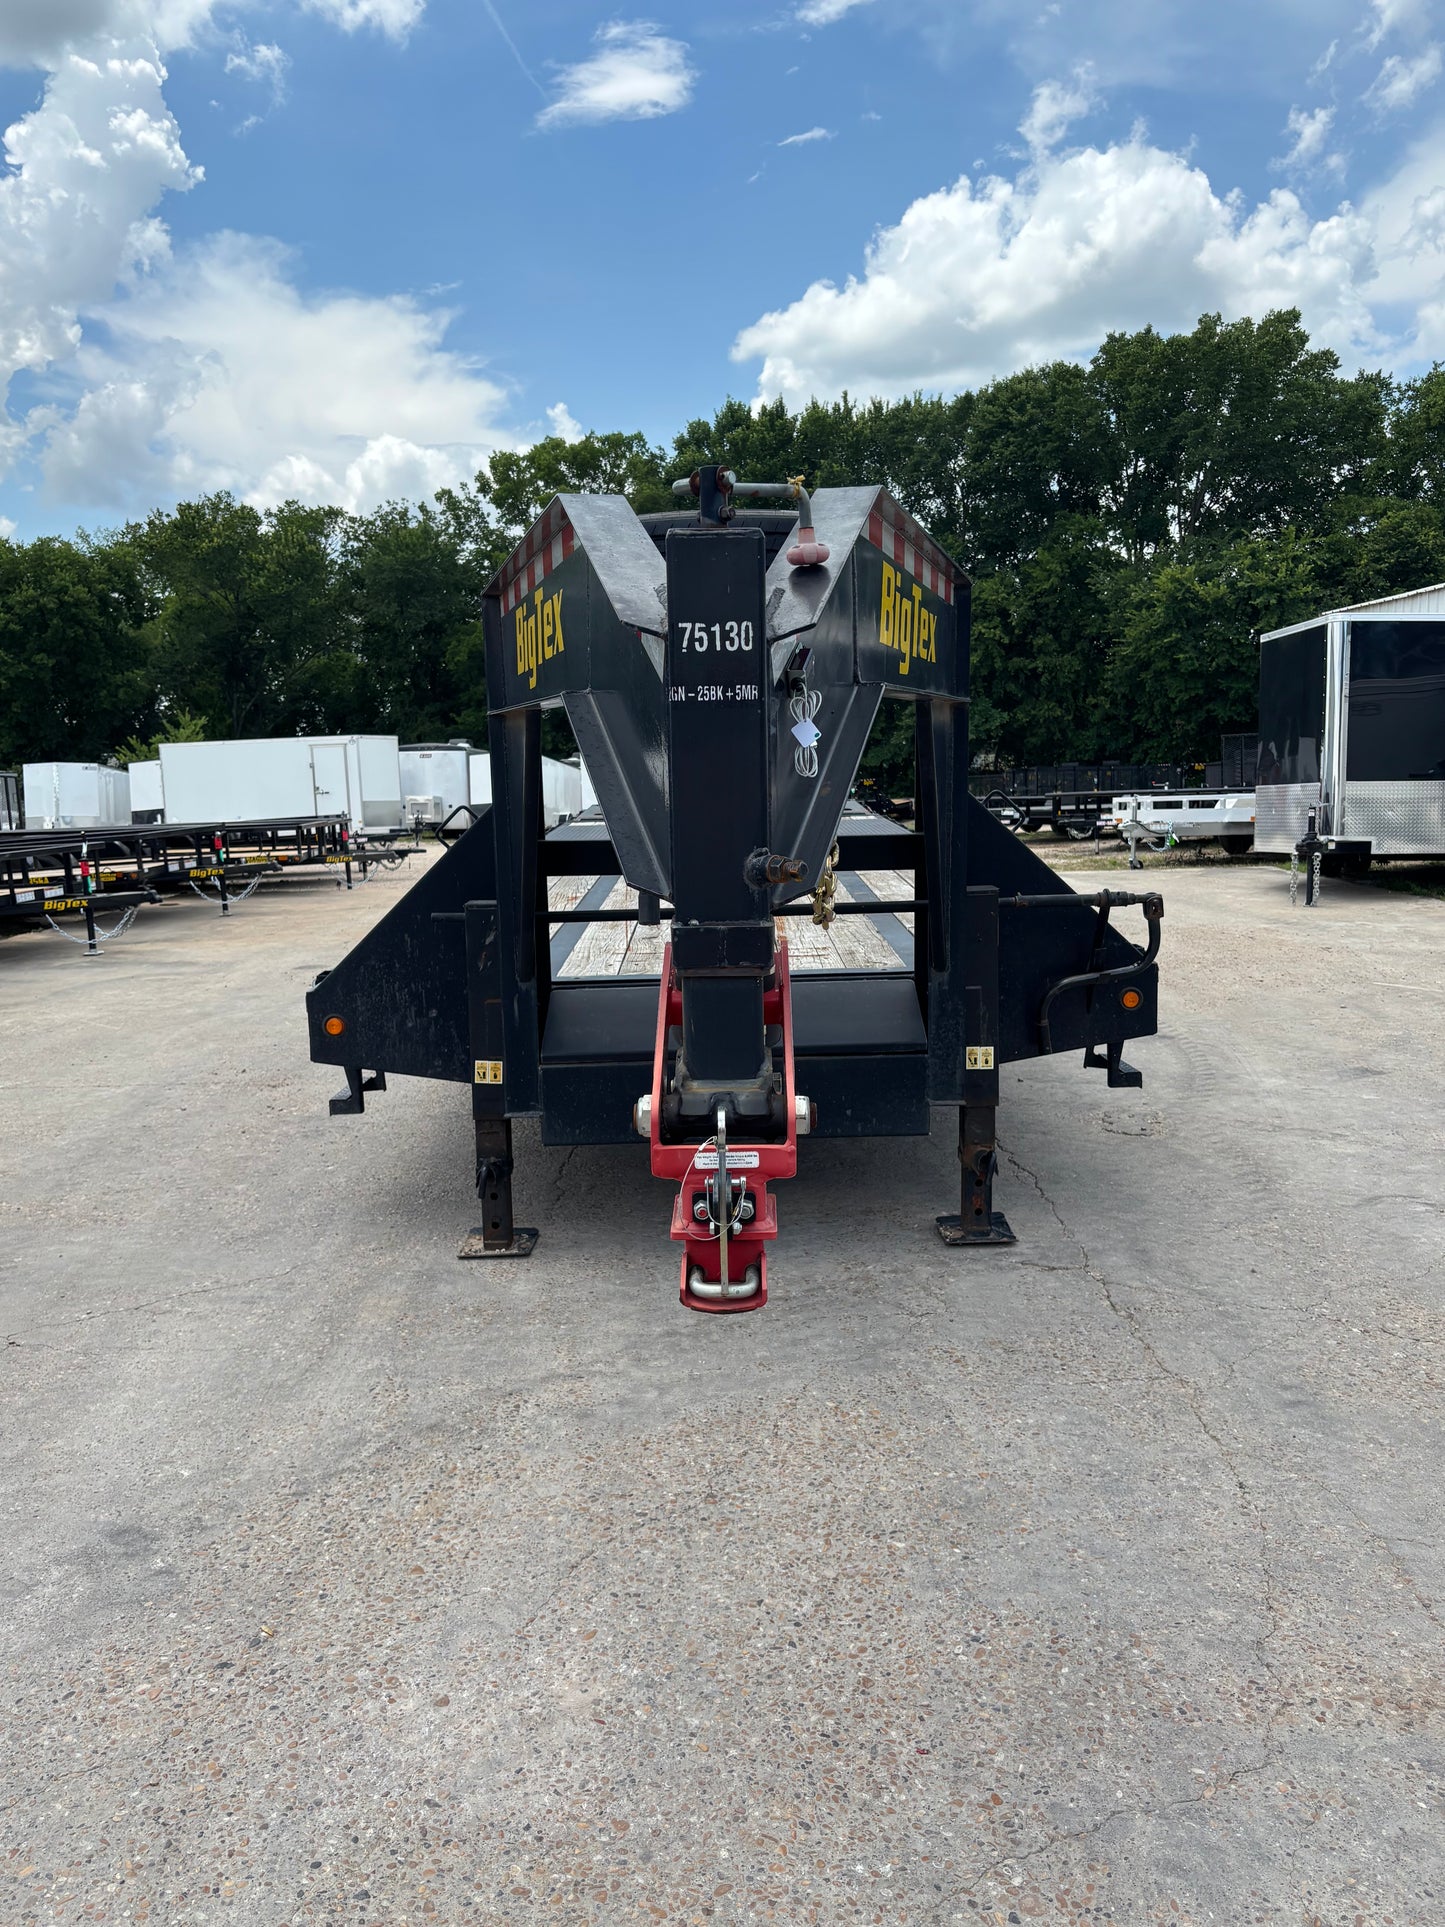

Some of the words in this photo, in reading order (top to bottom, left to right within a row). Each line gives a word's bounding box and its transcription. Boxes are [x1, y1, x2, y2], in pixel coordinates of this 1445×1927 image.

[880, 560, 937, 675] BigTex
[515, 586, 565, 690] BigTex
[678, 620, 753, 652] 75130
[189, 867, 224, 878] BigTex
[43, 899, 88, 911] BigTex
